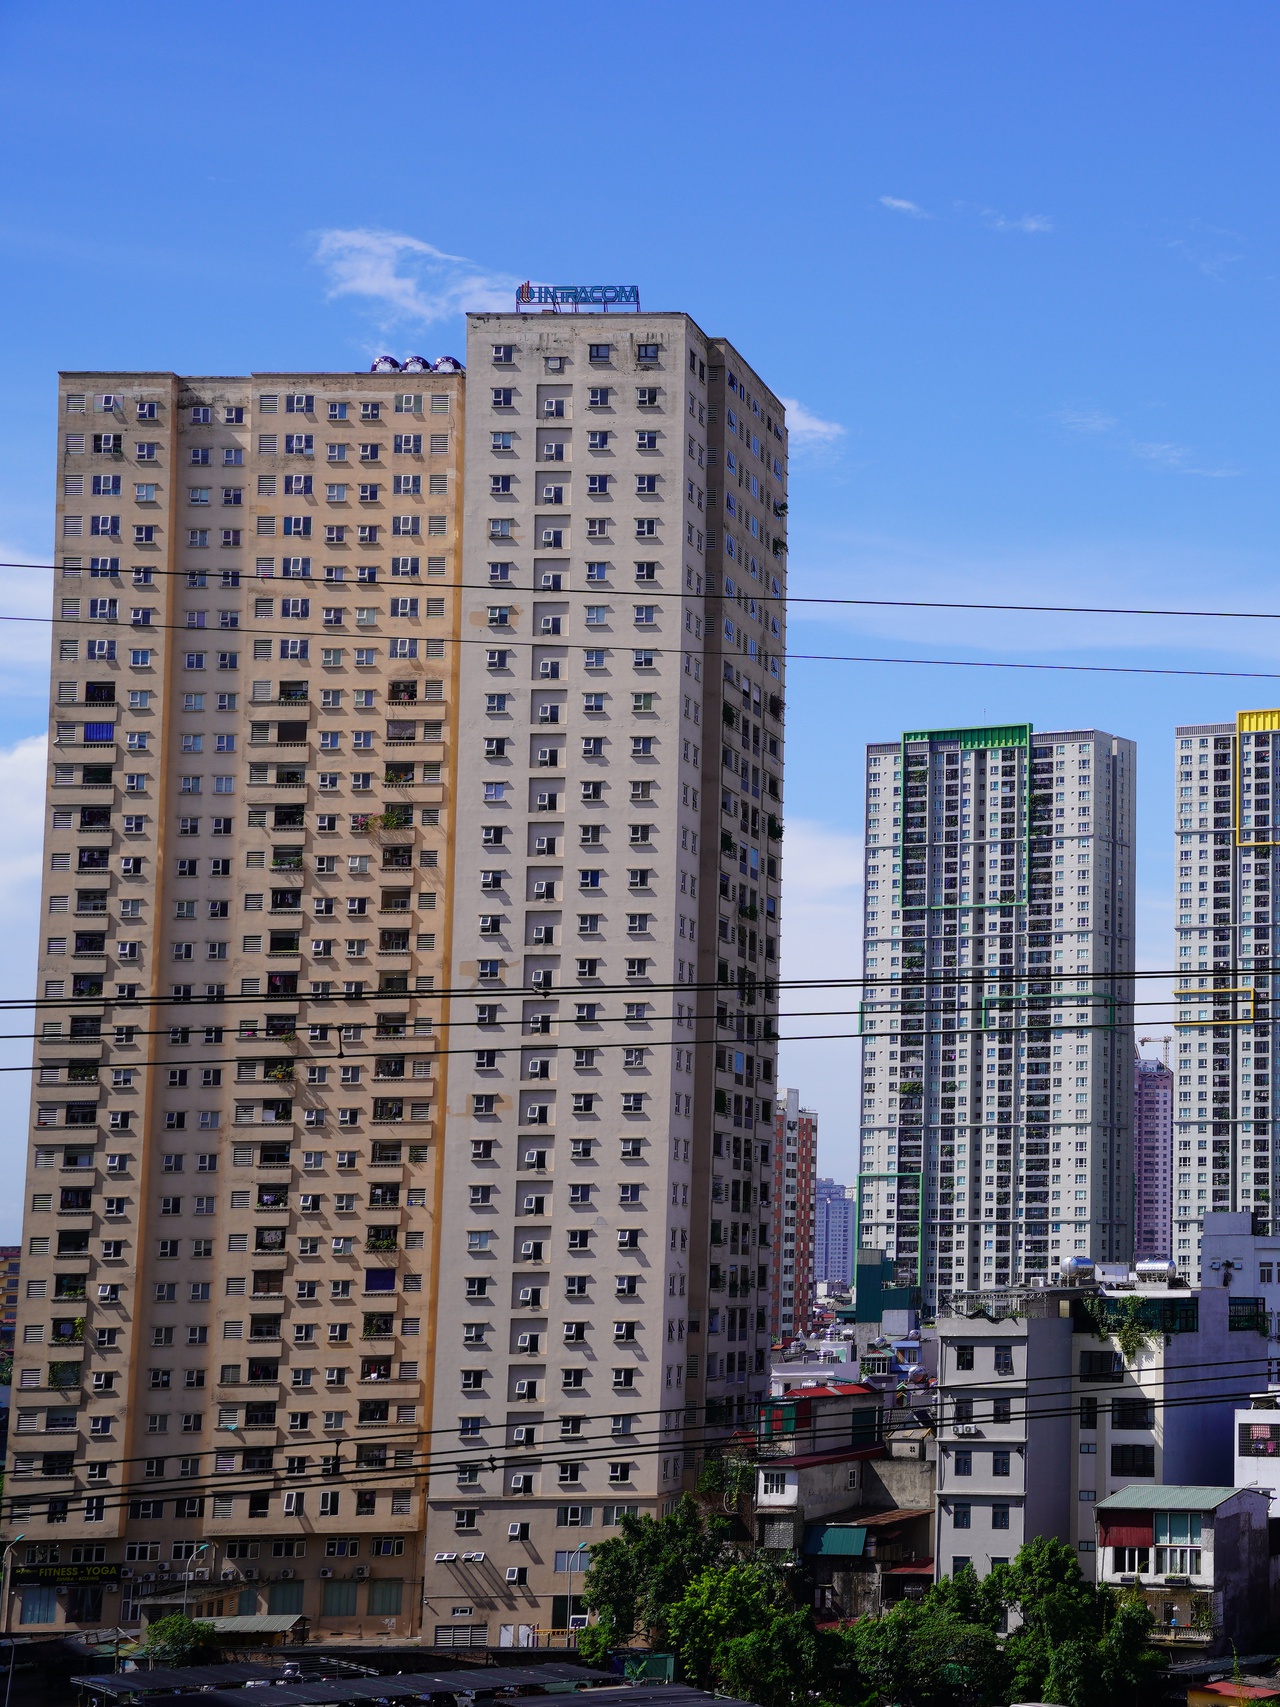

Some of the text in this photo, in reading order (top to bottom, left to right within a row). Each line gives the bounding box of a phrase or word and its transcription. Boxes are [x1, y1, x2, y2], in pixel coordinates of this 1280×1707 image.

[538, 285, 638, 303] INTRACOM
[39, 1567, 78, 1577] FITNESS
[86, 1566, 117, 1576] YOGA
